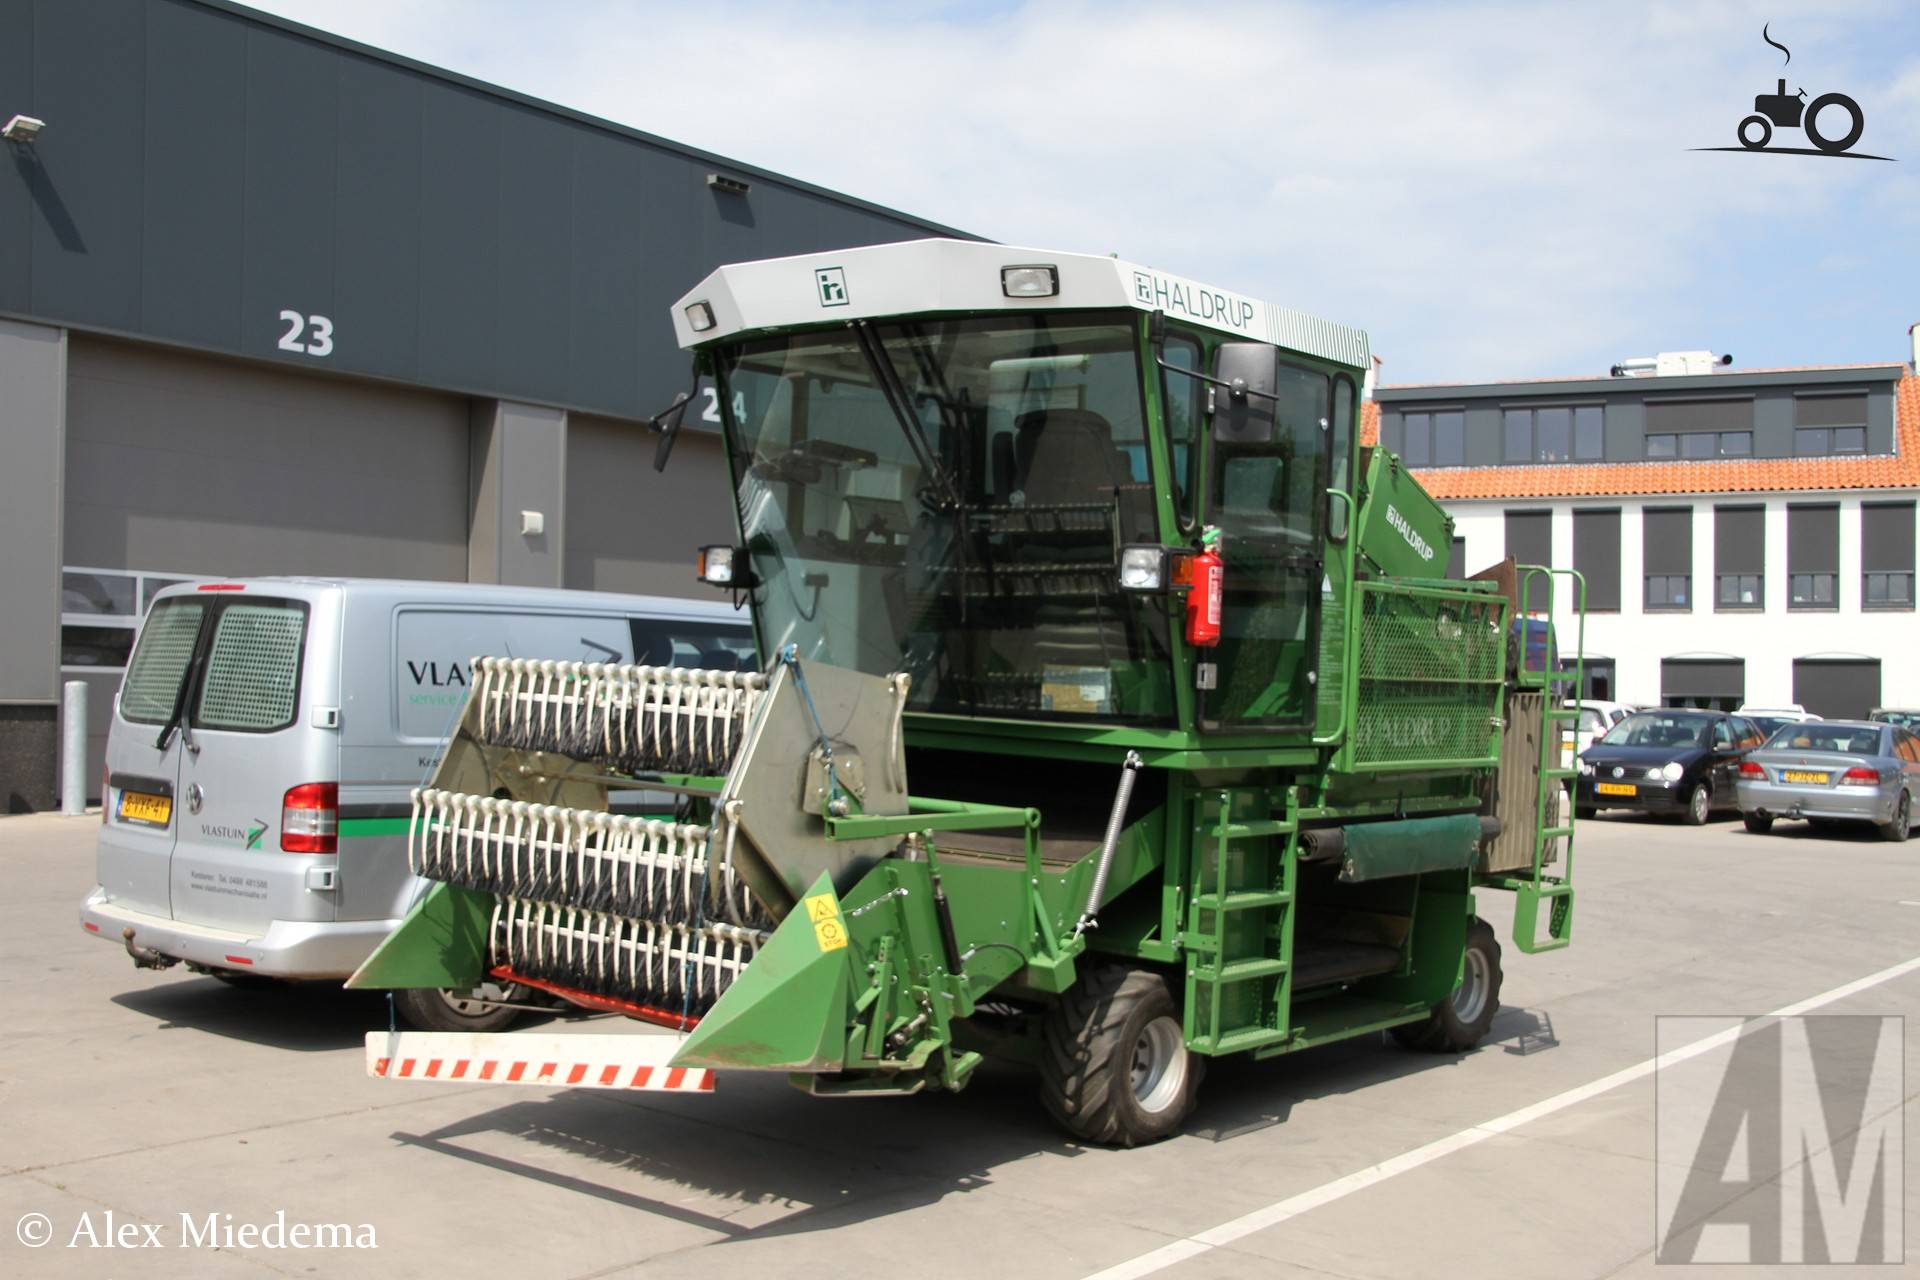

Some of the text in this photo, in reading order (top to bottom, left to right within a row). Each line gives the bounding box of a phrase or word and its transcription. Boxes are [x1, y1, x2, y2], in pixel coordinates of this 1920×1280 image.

[1153, 275, 1254, 329] HALDRUP
[278, 309, 334, 357] 23
[702, 386, 748, 424] 24
[1394, 511, 1434, 561] HALDRUP
[201, 823, 246, 840] VLASTUIN
